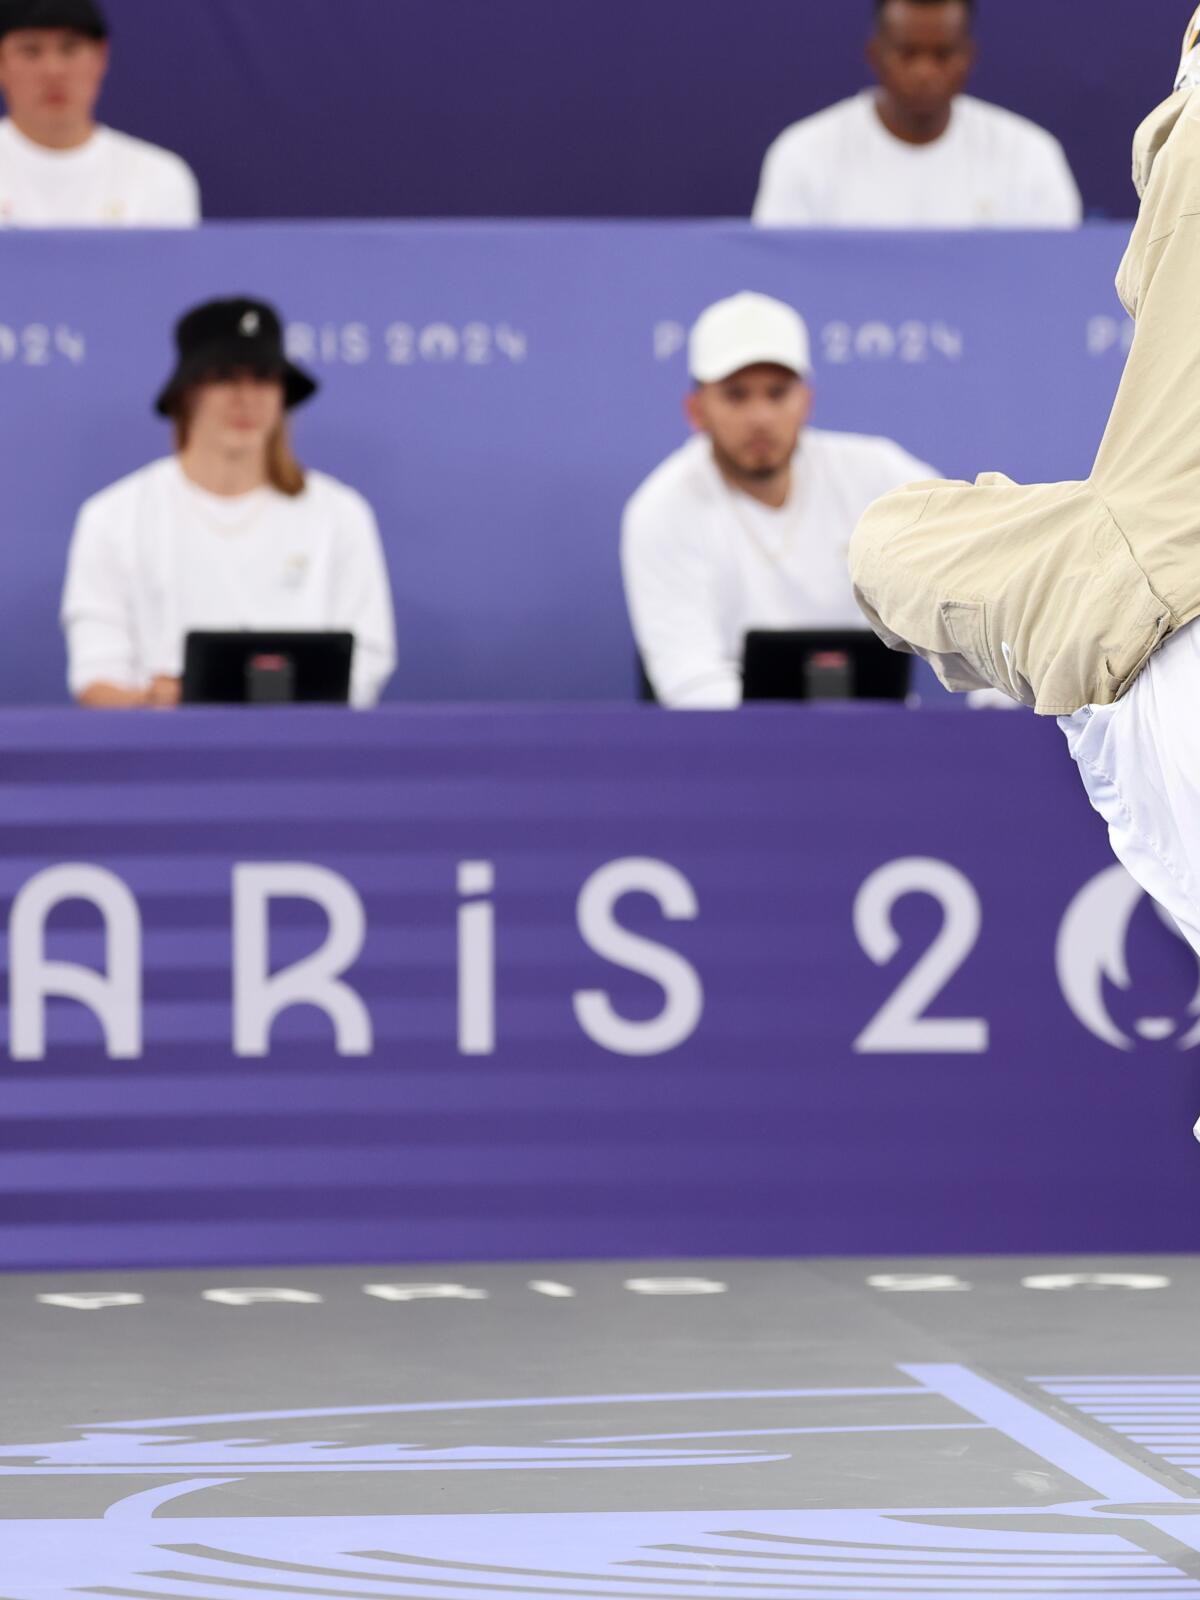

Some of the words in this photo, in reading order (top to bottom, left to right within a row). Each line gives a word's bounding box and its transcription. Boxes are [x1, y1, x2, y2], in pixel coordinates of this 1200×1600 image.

[285, 321, 370, 365] RIS
[384, 320, 528, 365] 2024
[821, 319, 963, 363] 2024
